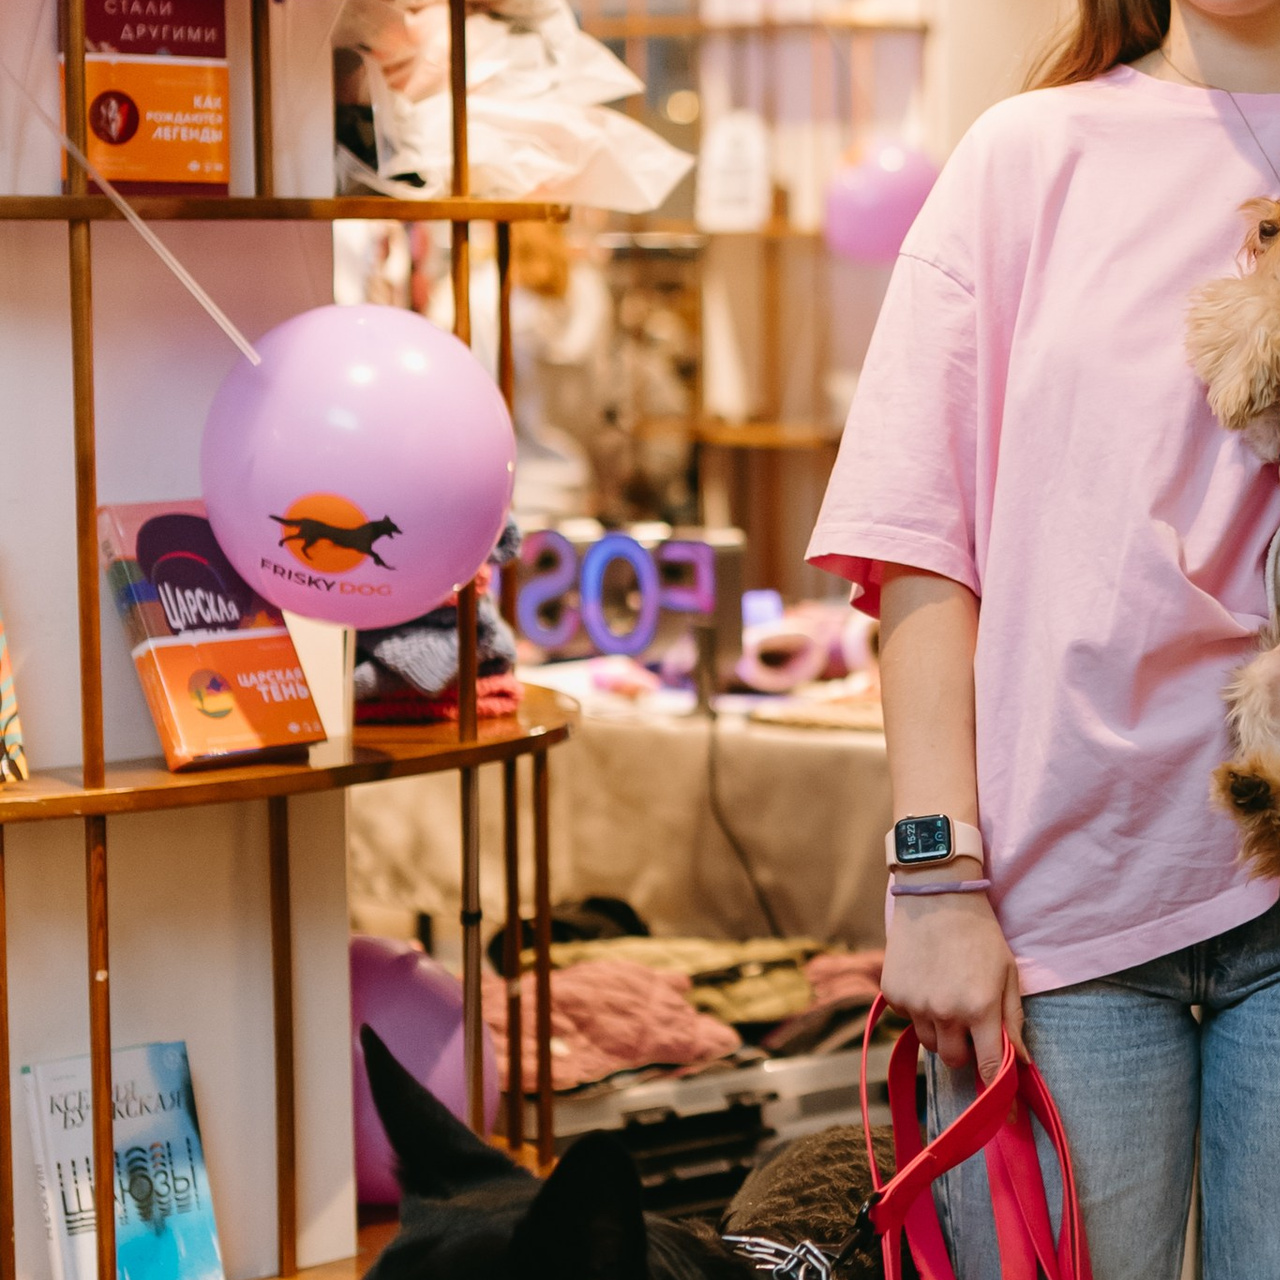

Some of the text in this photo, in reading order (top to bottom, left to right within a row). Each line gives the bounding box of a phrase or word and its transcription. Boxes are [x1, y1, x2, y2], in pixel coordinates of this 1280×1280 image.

[120, 23, 218, 43] ДРУГИМИ
[193, 95, 222, 110] КАК
[152, 126, 223, 144] ЛЕГЕНДЫ
[237, 668, 304, 688] ЦАРСКАЯ
[257, 682, 309, 704] ТЕНЬ
